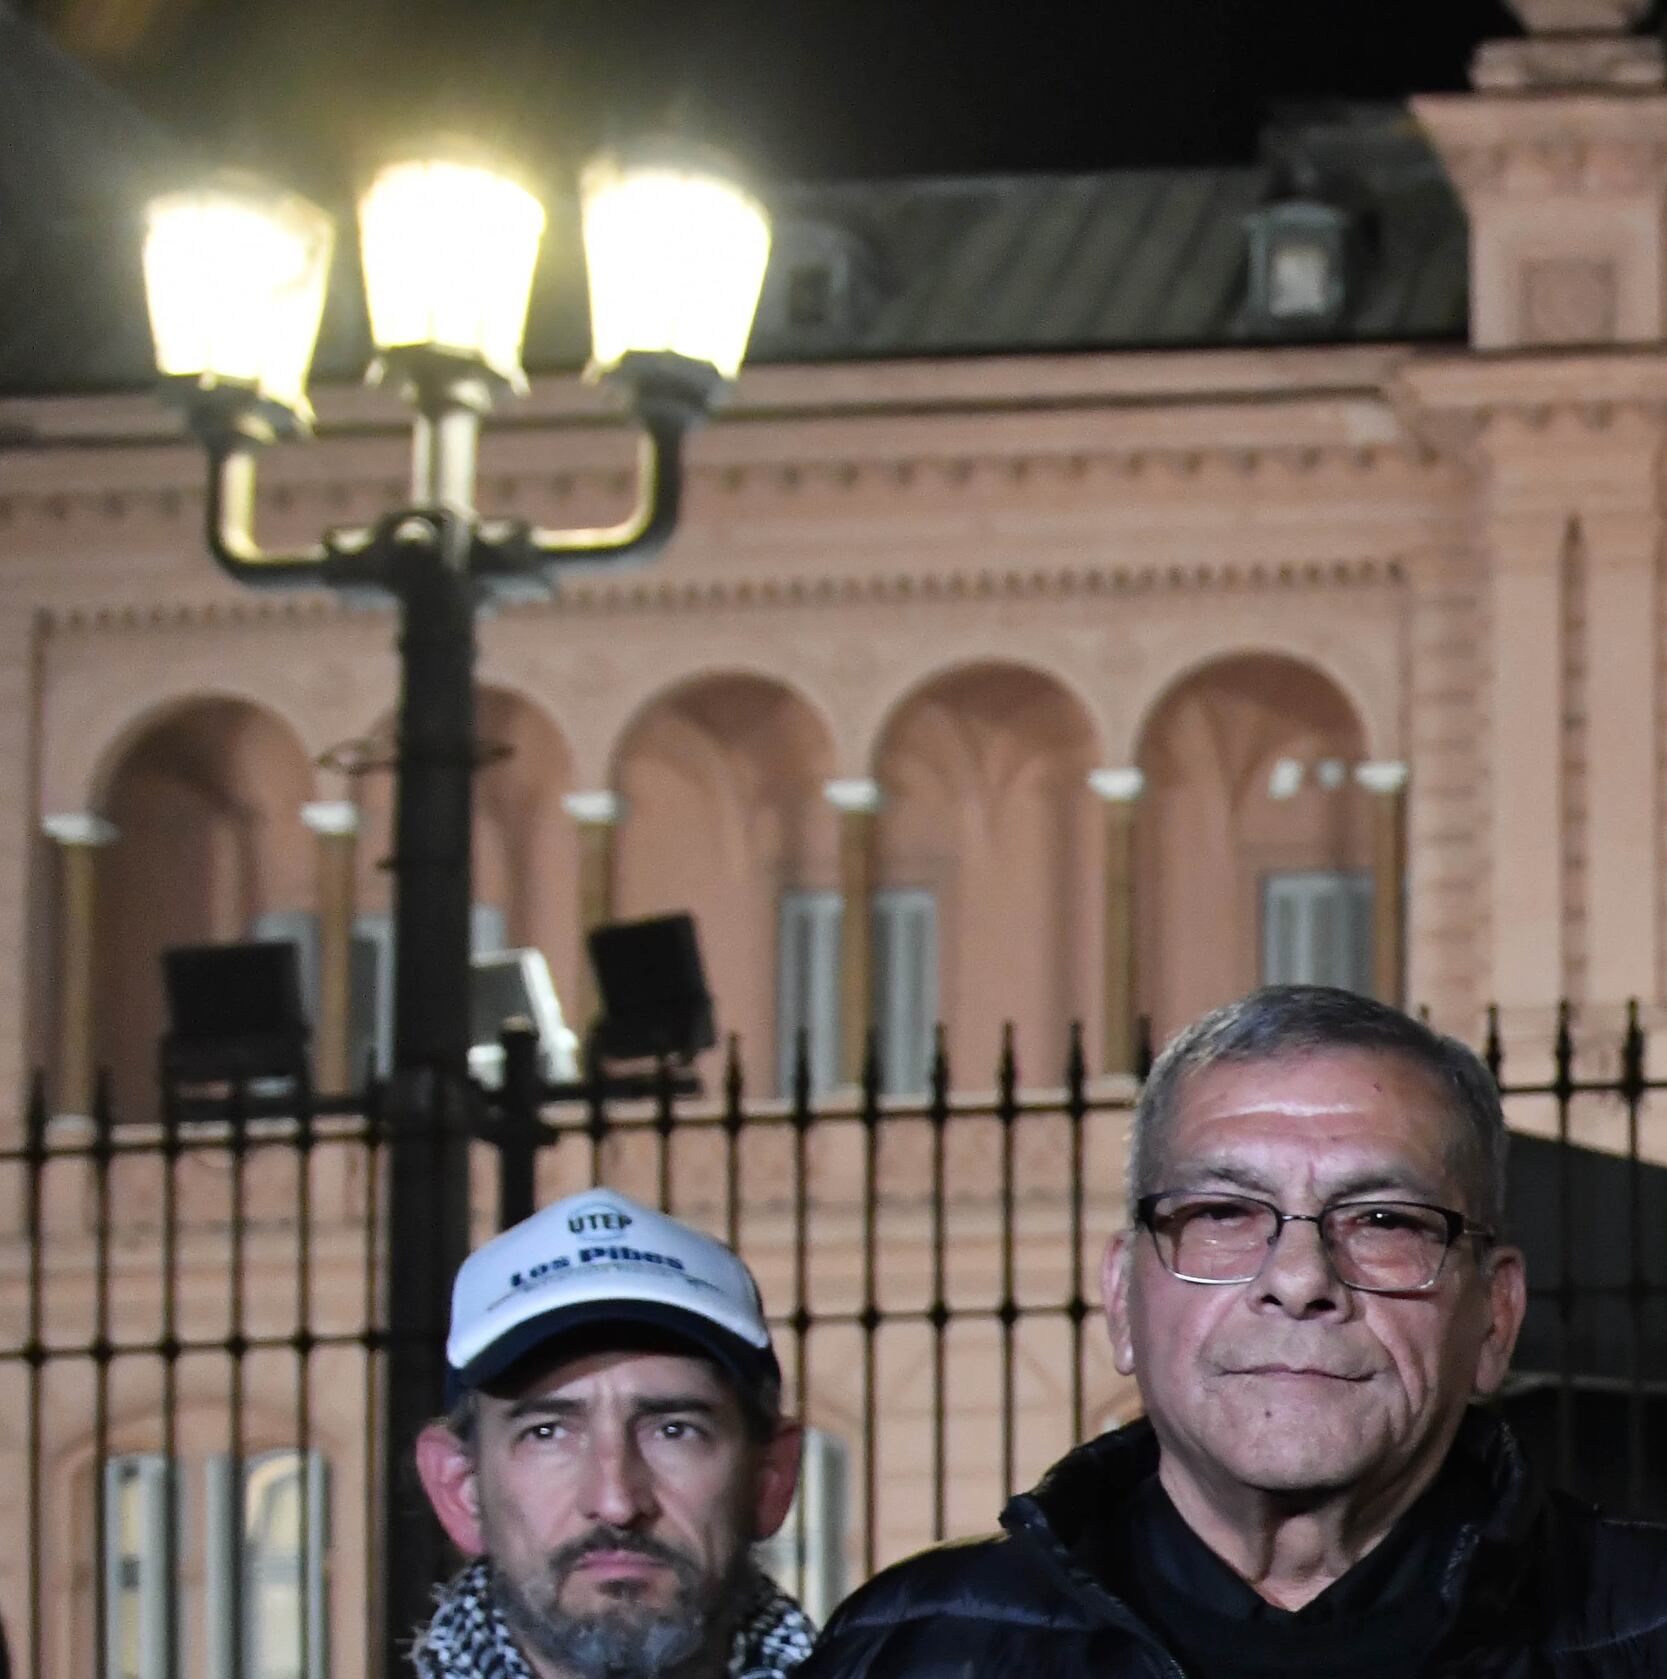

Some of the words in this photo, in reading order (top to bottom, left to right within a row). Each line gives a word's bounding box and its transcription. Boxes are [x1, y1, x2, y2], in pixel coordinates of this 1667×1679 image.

[568, 1213, 632, 1234] UTEP
[511, 1255, 570, 1286] Los
[579, 1246, 684, 1270] Pibes
